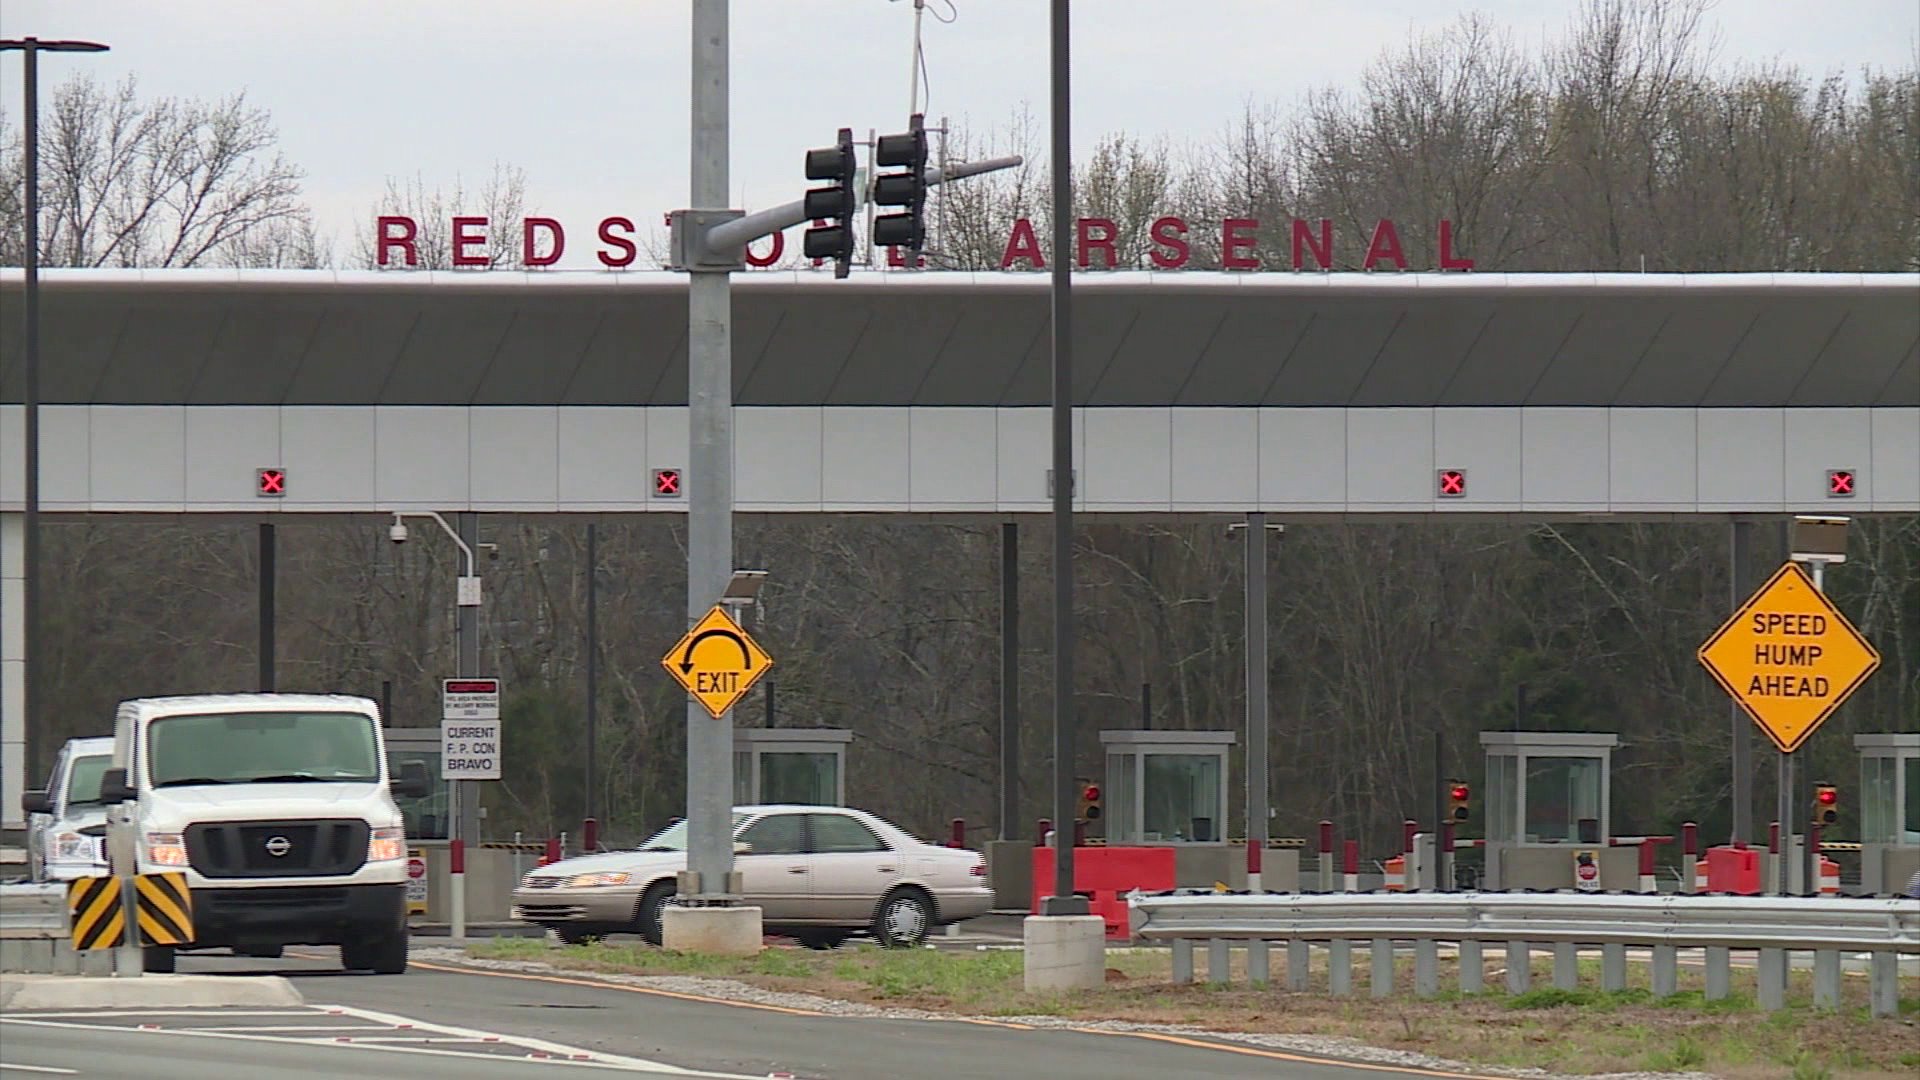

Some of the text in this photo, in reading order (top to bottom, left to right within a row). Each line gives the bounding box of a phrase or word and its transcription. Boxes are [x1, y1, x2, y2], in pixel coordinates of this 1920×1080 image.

[377, 216, 1475, 269] REDSO ARSENAL
[1752, 613, 1826, 635] SPEED
[1755, 644, 1822, 666] HUMP
[697, 672, 739, 693] EXIT
[1748, 675, 1829, 697] AHEAD
[447, 727, 495, 738] CURRENT
[473, 743, 495, 754] CON
[447, 758, 492, 770] BRAVO
